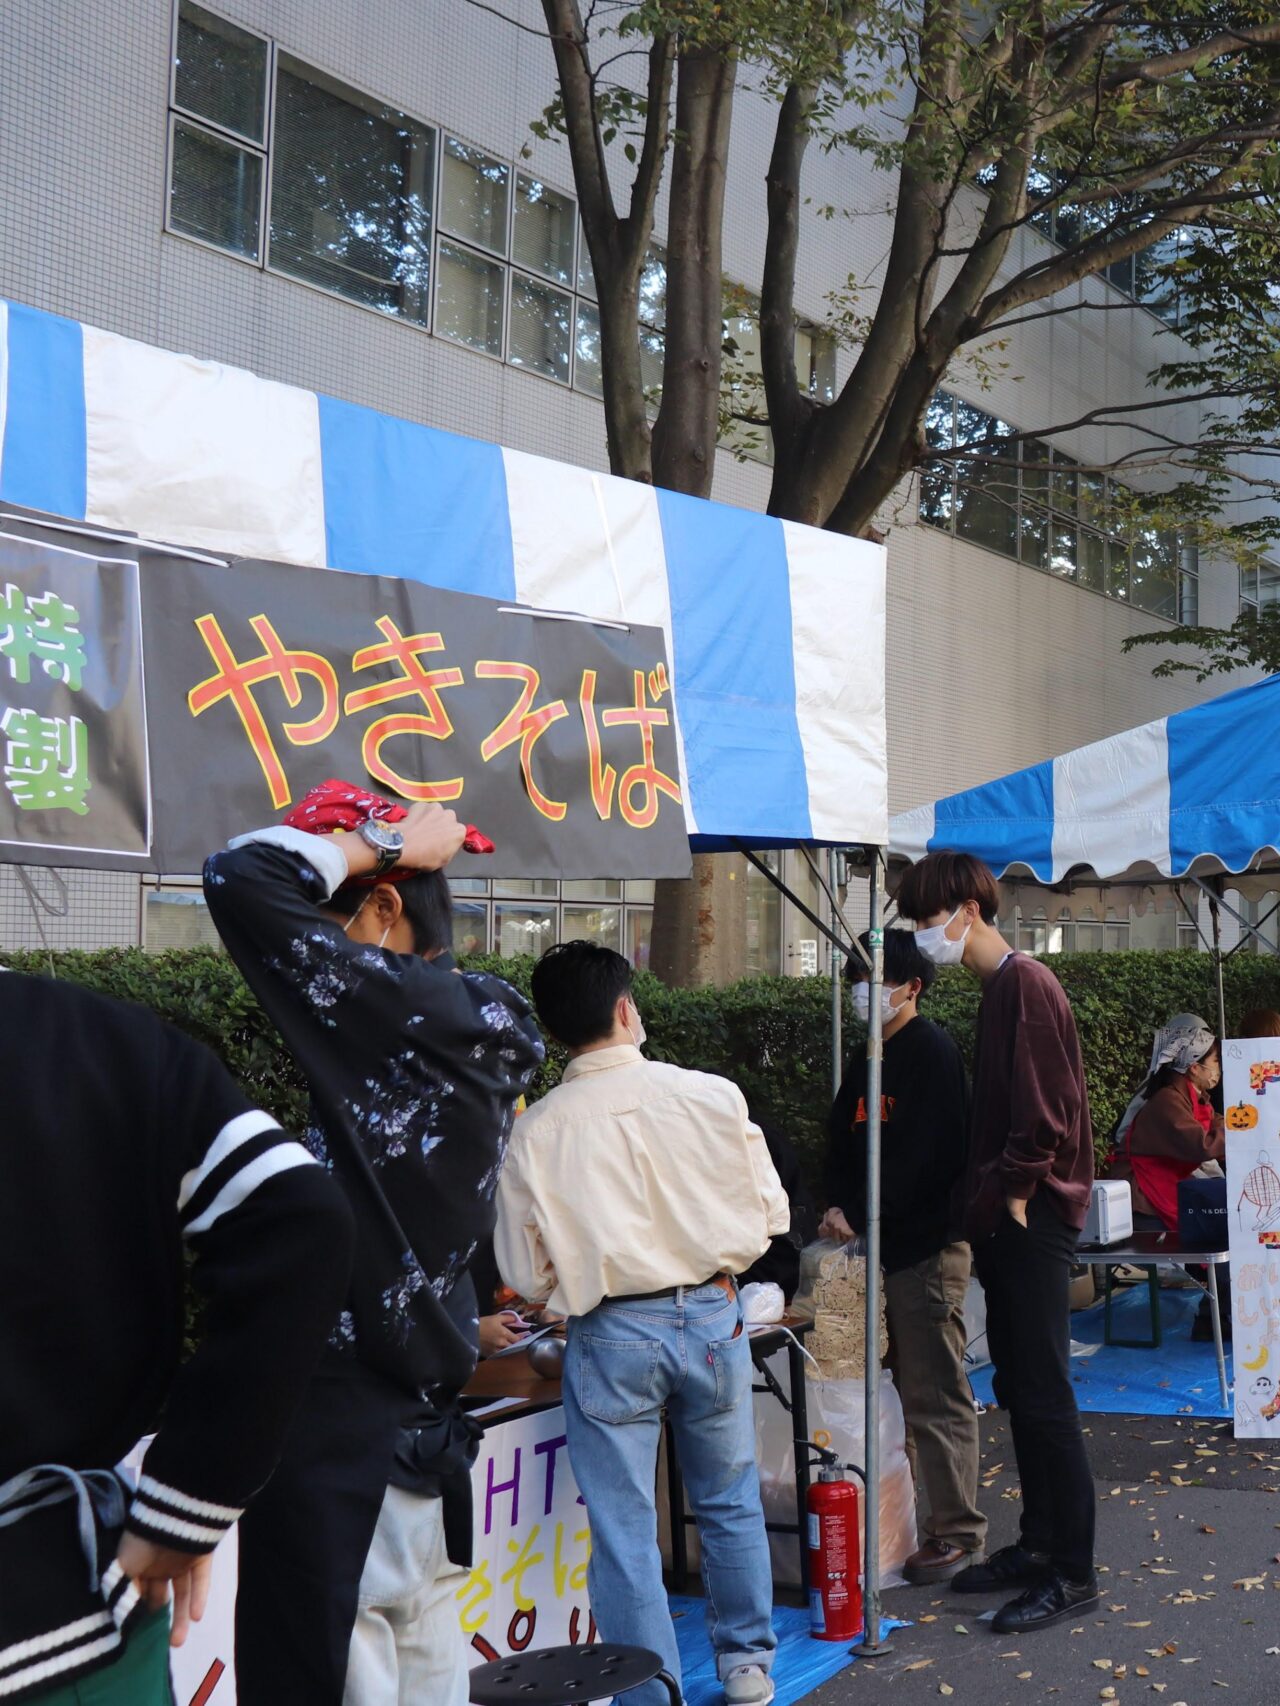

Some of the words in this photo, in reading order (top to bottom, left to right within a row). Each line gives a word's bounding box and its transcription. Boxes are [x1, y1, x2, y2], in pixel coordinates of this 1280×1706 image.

[0, 583, 91, 815] 特製
[188, 612, 682, 829] やきそば
[484, 1433, 587, 1535] HT
